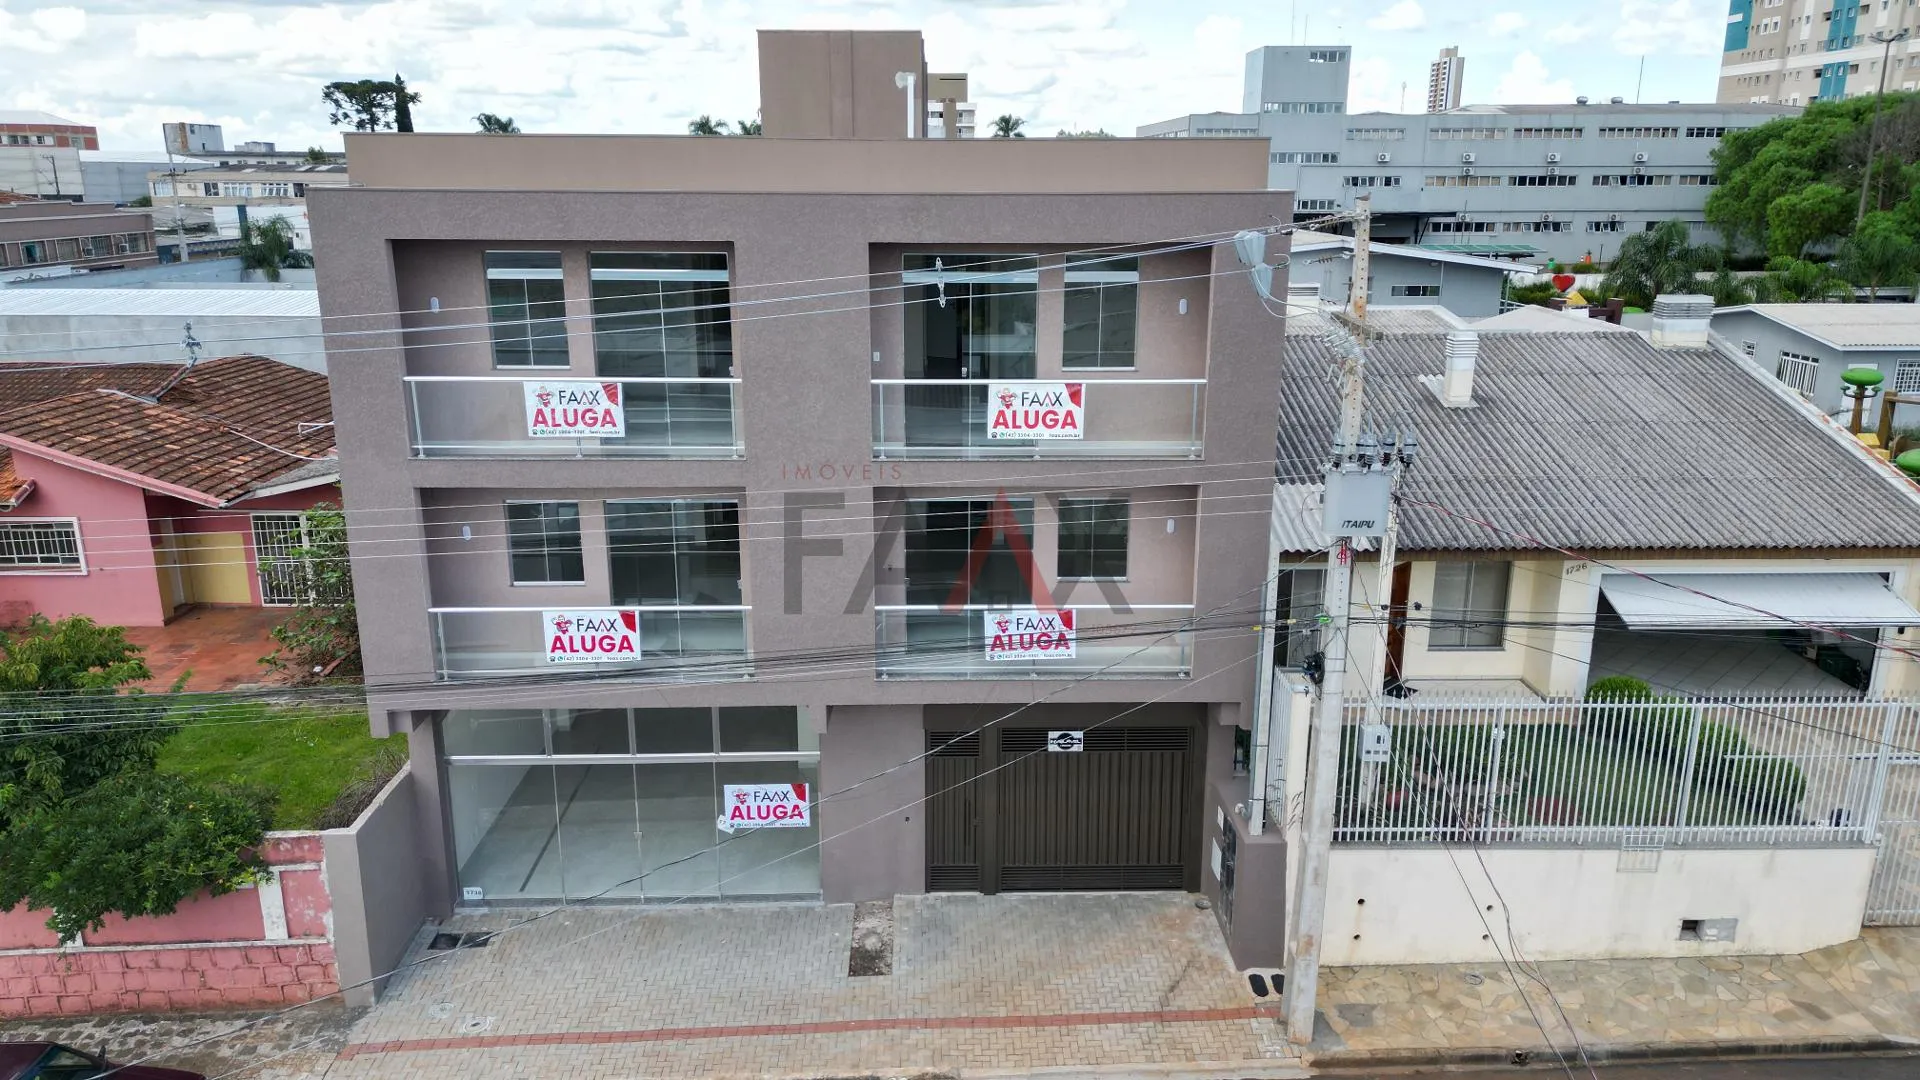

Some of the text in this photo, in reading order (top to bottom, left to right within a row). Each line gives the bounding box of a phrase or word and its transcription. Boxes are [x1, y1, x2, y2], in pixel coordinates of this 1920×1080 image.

[532, 408, 618, 428] ALUGA
[992, 409, 1078, 430] ALUGA
[1341, 520, 1375, 529] ITAIPU
[1566, 563, 1588, 575] 1726
[550, 634, 635, 653] ALUGA
[990, 632, 1071, 652] ALUGA
[730, 804, 804, 821] ALUGA
